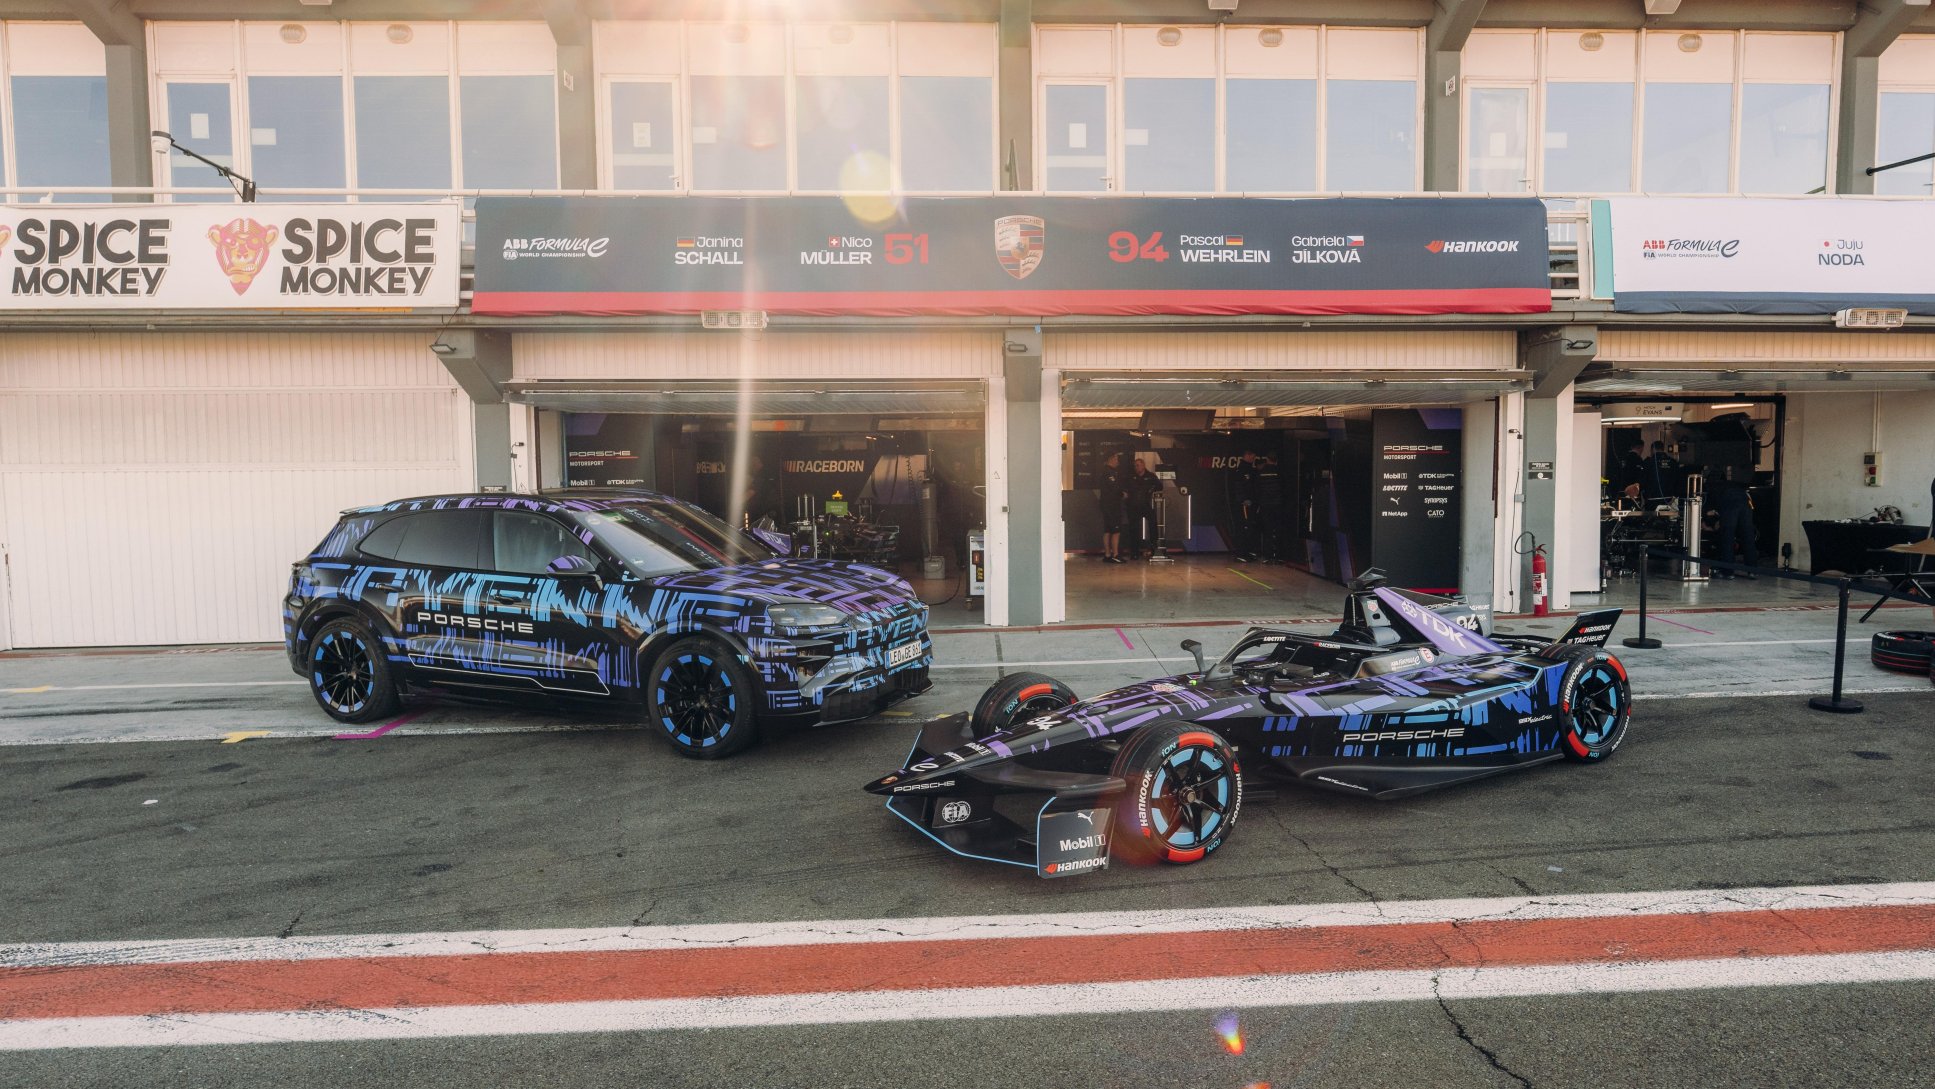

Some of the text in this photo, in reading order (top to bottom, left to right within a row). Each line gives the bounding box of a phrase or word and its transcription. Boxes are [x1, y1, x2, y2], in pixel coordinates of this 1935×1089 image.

[14, 218, 170, 264] SPICE
[281, 218, 437, 264] SPICE
[503, 239, 528, 249] ABB
[529, 237, 590, 251] FORMULA
[696, 236, 743, 248] Janina
[842, 236, 872, 248] Nico
[1107, 231, 1169, 263] 94
[1180, 234, 1223, 246] Pascal
[1291, 235, 1345, 247] Gabriela
[1643, 240, 1665, 249] ABB
[1666, 239, 1722, 251] FORMULA
[1837, 239, 1864, 250] Juju
[503, 250, 518, 260] FIA
[884, 233, 928, 265] 51
[674, 251, 743, 265] SCHALL
[800, 249, 872, 265] MÜLLER
[1180, 250, 1270, 263] WEHRLEIN
[1818, 252, 1865, 266] NODA
[12, 267, 167, 296] MONKEY
[280, 266, 432, 295] MONKEY
[795, 460, 865, 473] RACEBORN
[570, 479, 588, 487] Mobil
[1383, 472, 1401, 480] Mobil
[417, 611, 534, 634] PORSCHE
[1416, 606, 1467, 650] TDK
[1456, 613, 1479, 631] 94
[1343, 728, 1466, 743] PORSCHE
[893, 780, 955, 793] PORSCHE
[943, 803, 970, 820] FIA
[1060, 836, 1093, 852] Mobil
